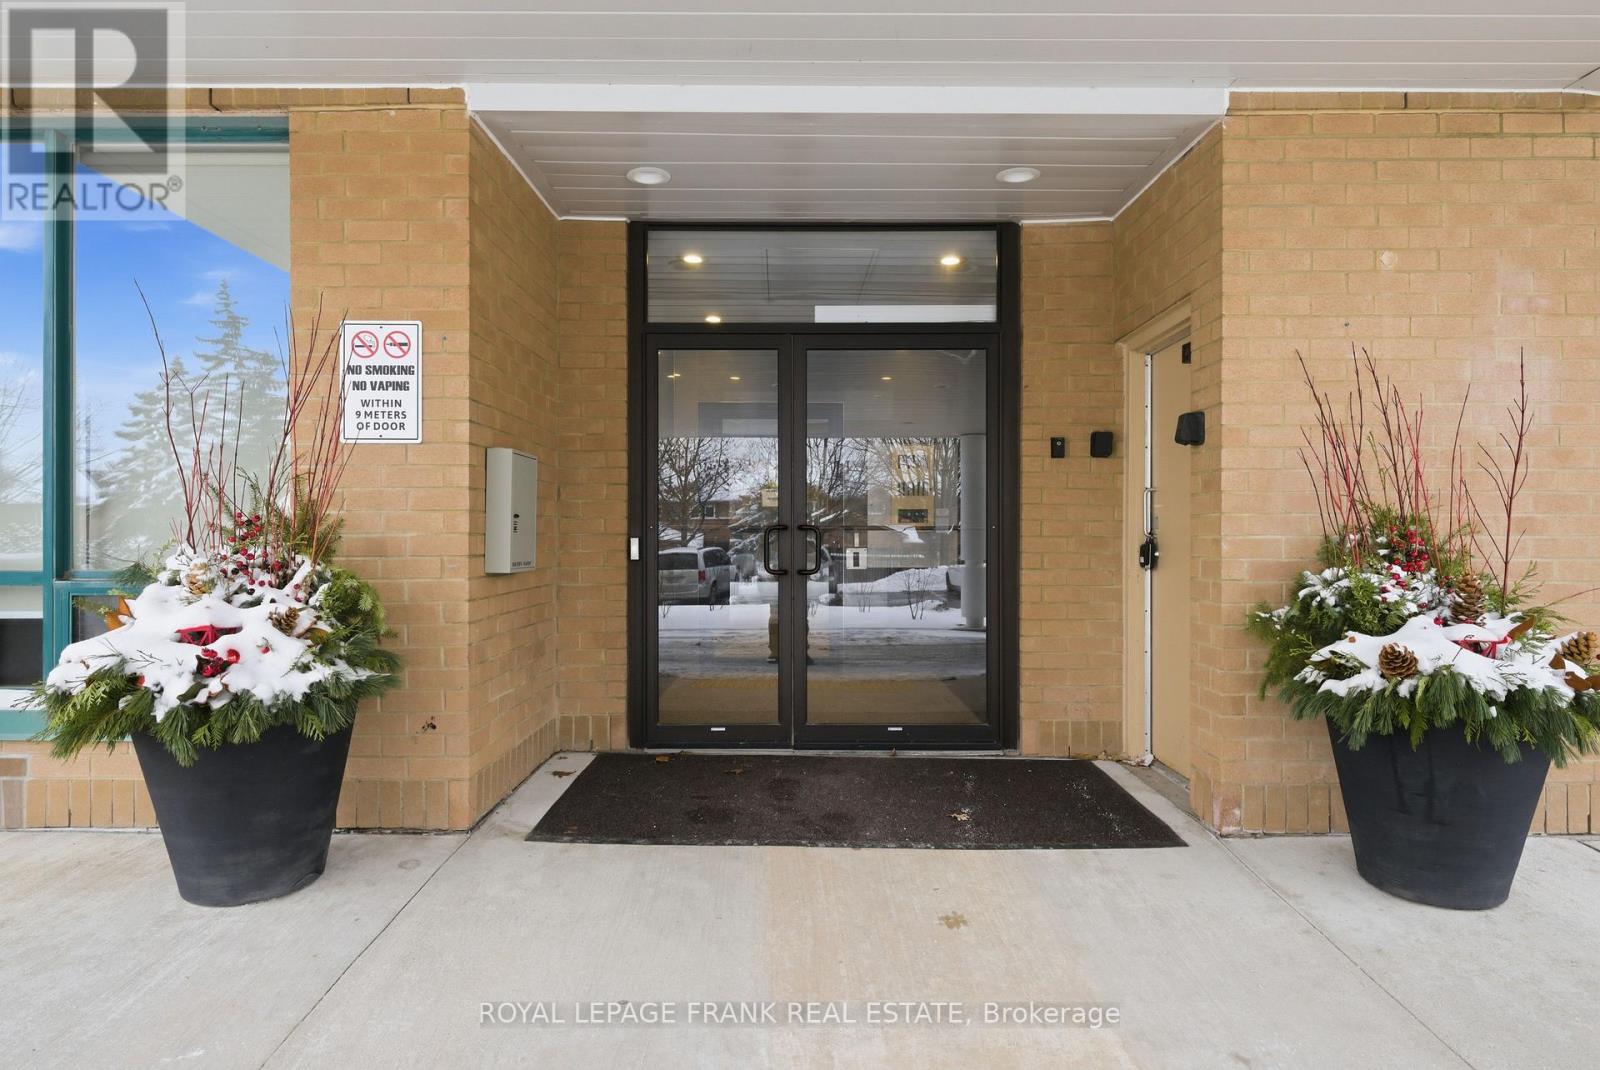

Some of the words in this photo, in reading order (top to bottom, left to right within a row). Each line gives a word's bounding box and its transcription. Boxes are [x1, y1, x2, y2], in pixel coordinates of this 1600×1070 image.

[347, 365, 362, 375] NO
[365, 365, 415, 375] SMOKING
[352, 381, 367, 391] NO
[370, 381, 410, 391] VAPING
[360, 399, 402, 408] WITHIN
[355, 410, 361, 419] 9
[364, 410, 407, 419] METERS
[356, 422, 371, 431] OF
[373, 422, 406, 431] DOOR
